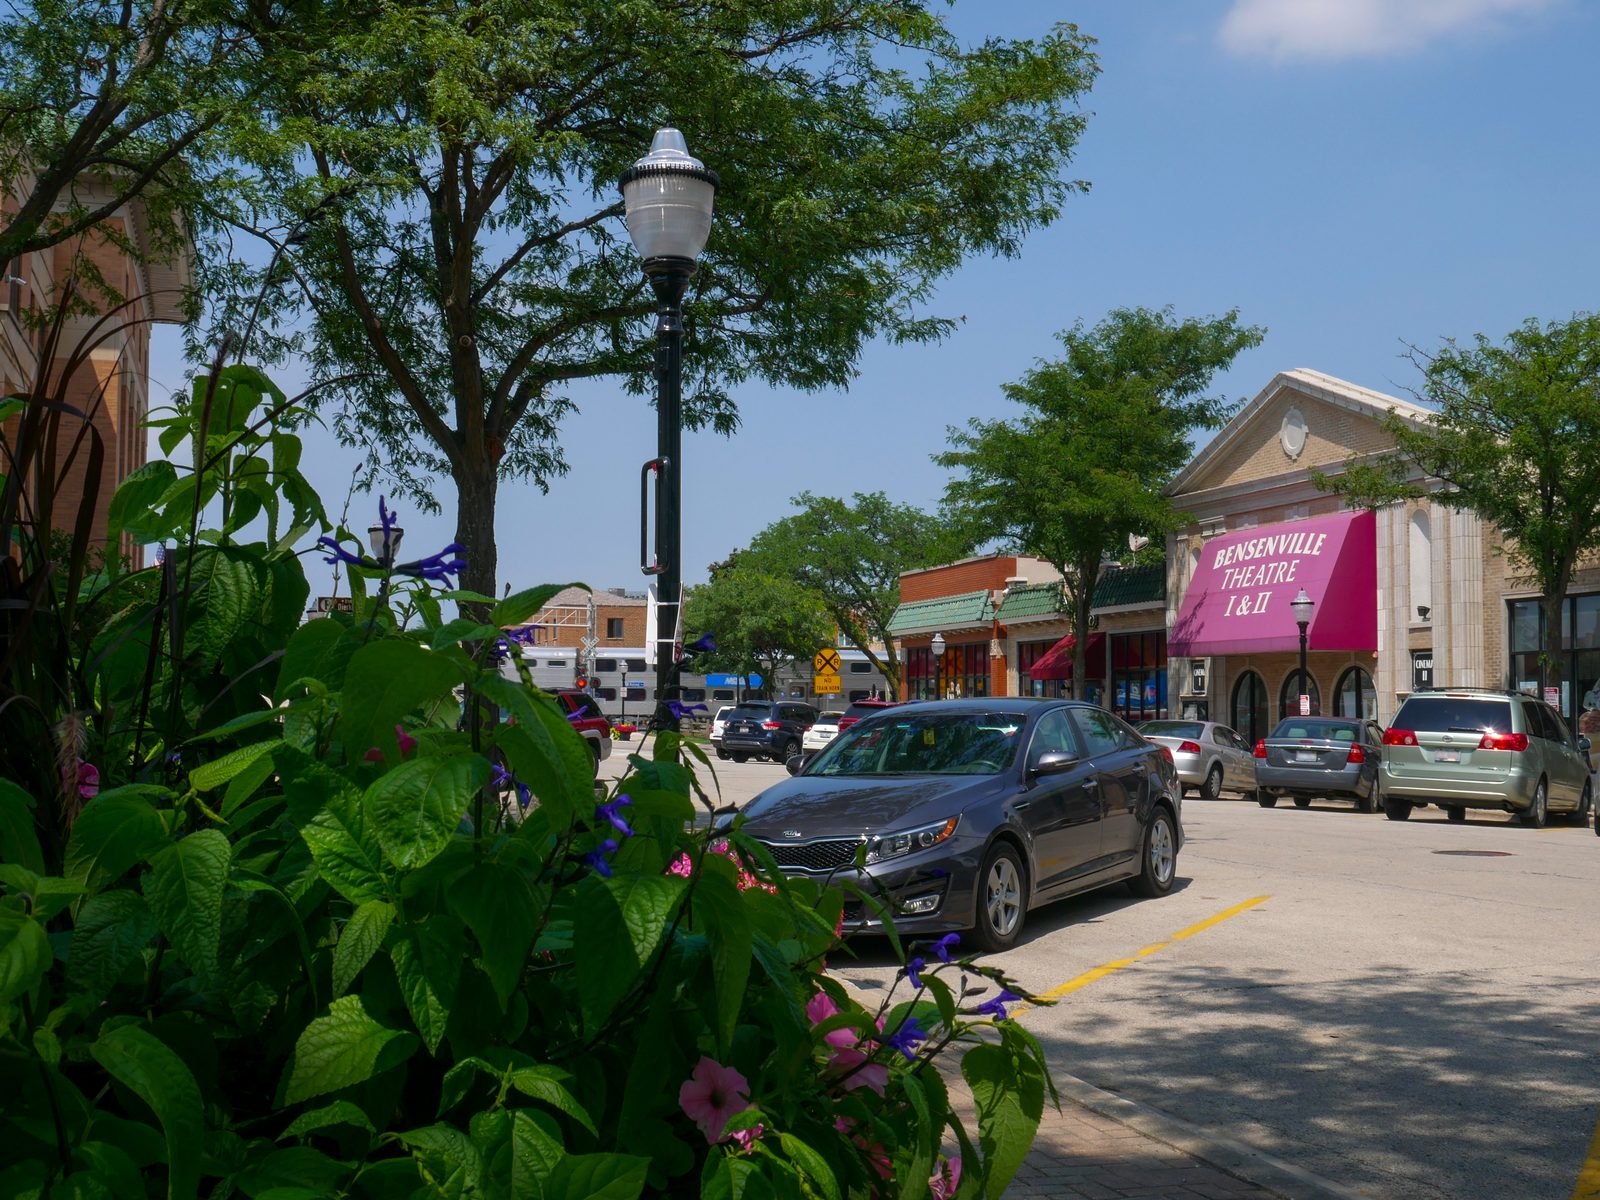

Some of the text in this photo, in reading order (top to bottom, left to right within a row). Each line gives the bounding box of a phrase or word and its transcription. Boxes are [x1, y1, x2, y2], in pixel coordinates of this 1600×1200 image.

[1213, 533, 1327, 570] BENSENVILLE
[1221, 560, 1300, 590] THEATRE
[1224, 595, 1237, 617] I
[1236, 595, 1252, 616] &
[817, 658, 839, 666] R R
